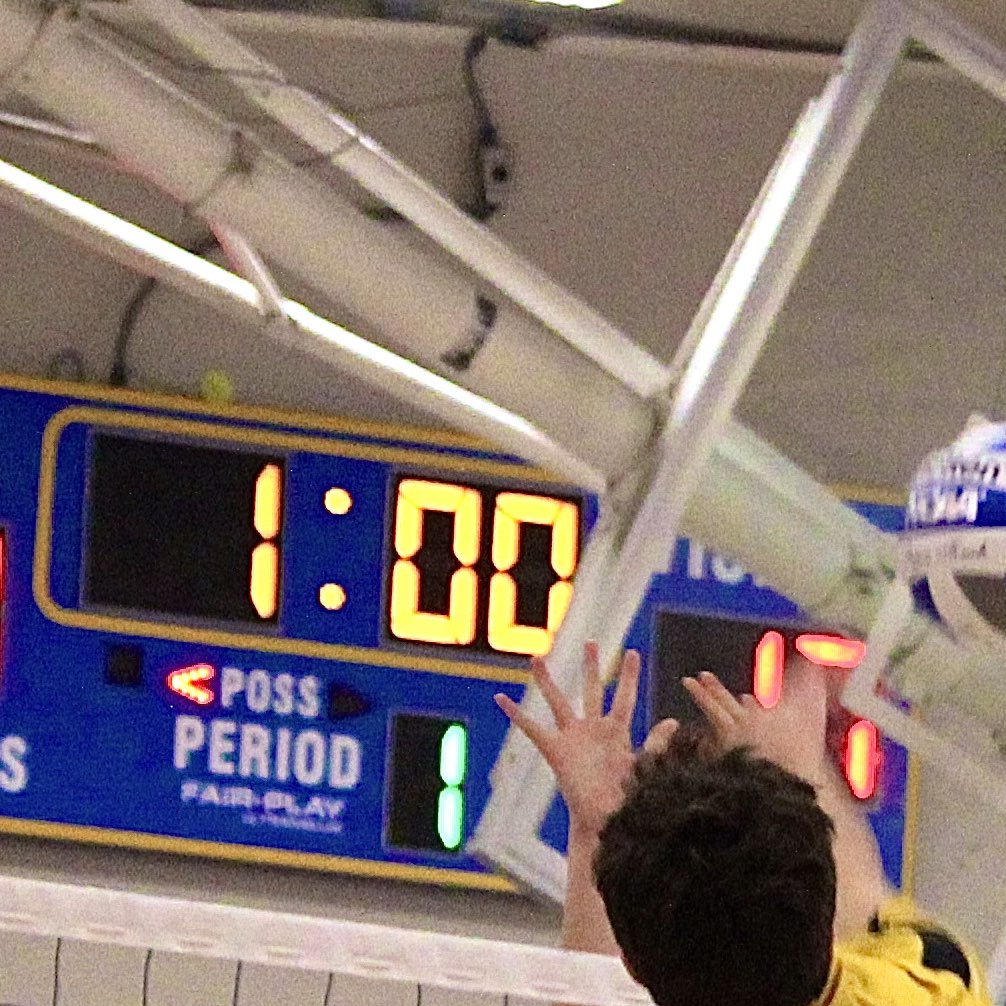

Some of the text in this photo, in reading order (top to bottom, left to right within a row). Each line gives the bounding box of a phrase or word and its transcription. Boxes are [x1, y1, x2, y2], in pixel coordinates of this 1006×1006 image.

[249, 462, 581, 657] 1:00
[221, 667, 319, 718] POSS
[173, 714, 362, 789] PERIOD
[437, 723, 468, 851] 1
